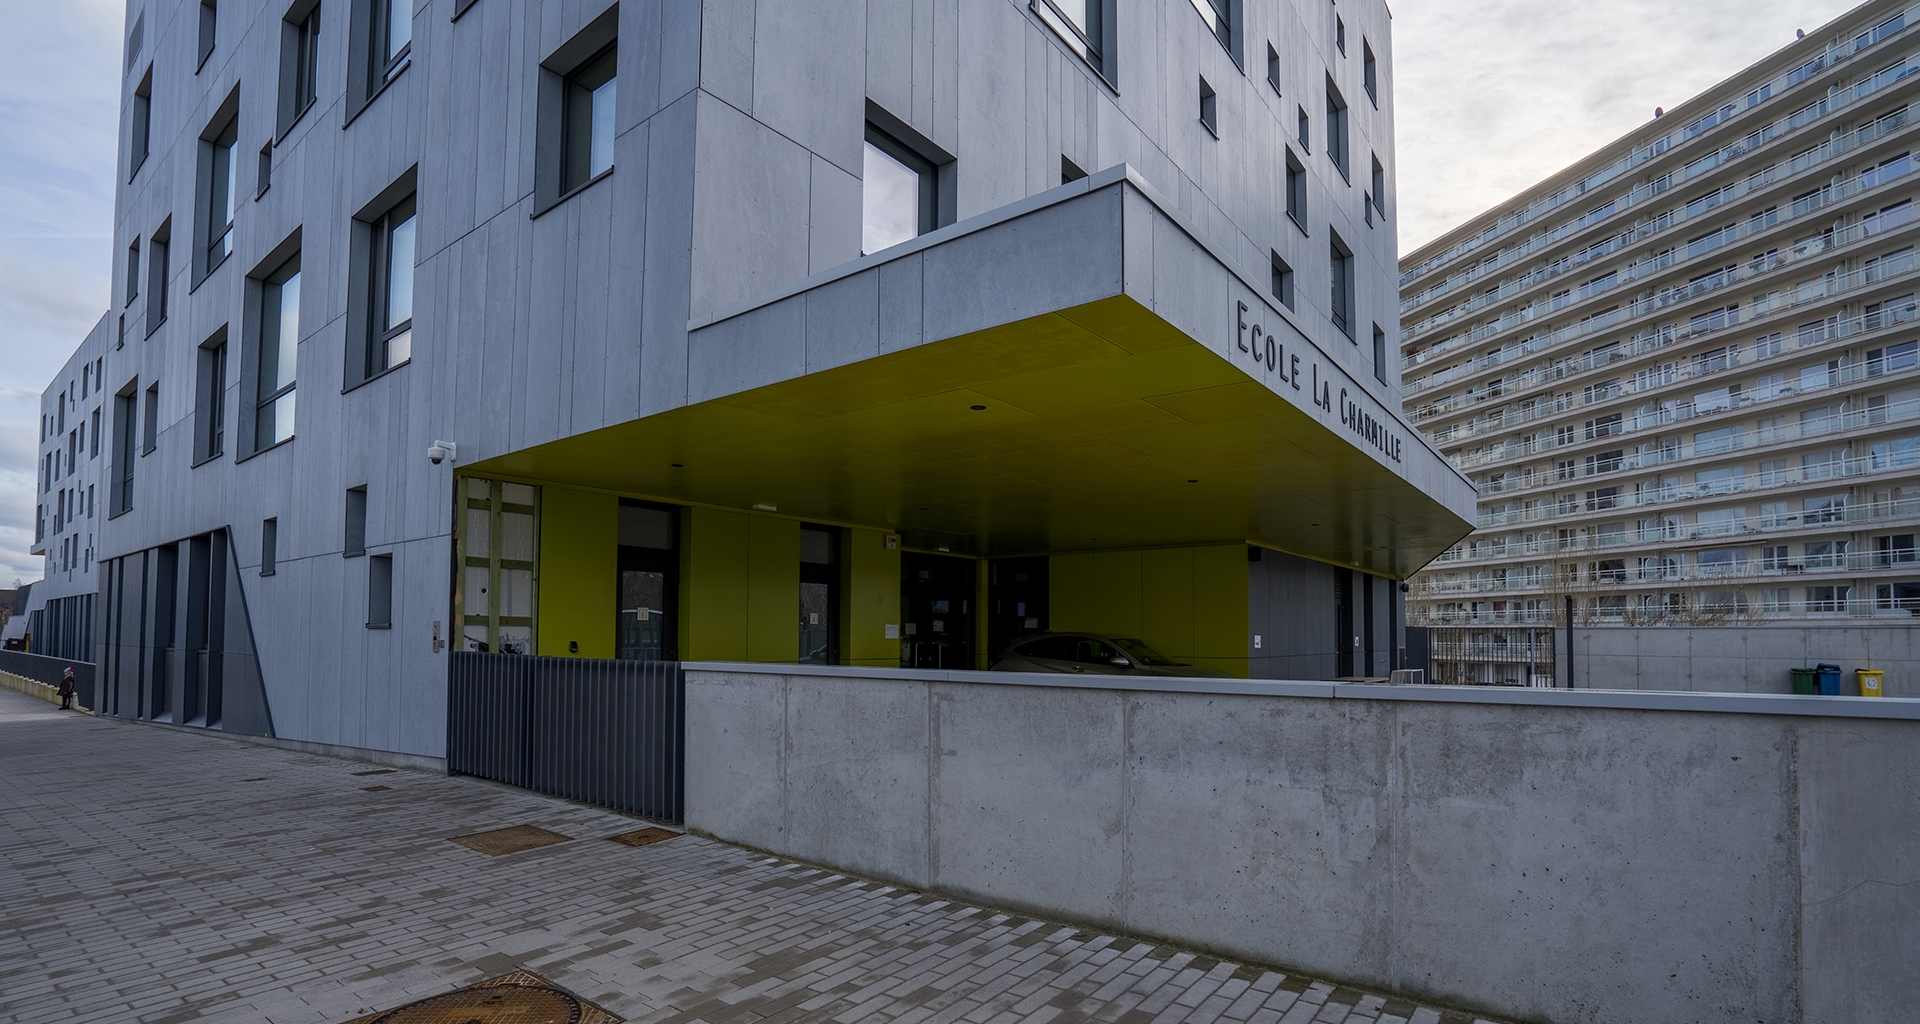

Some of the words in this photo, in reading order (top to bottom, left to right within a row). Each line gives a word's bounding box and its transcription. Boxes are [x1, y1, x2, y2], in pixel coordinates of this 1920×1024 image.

[1237, 300, 1300, 390] ECOLE
[1313, 363, 1331, 413] LA
[1340, 387, 1401, 463] CHARMILLE
